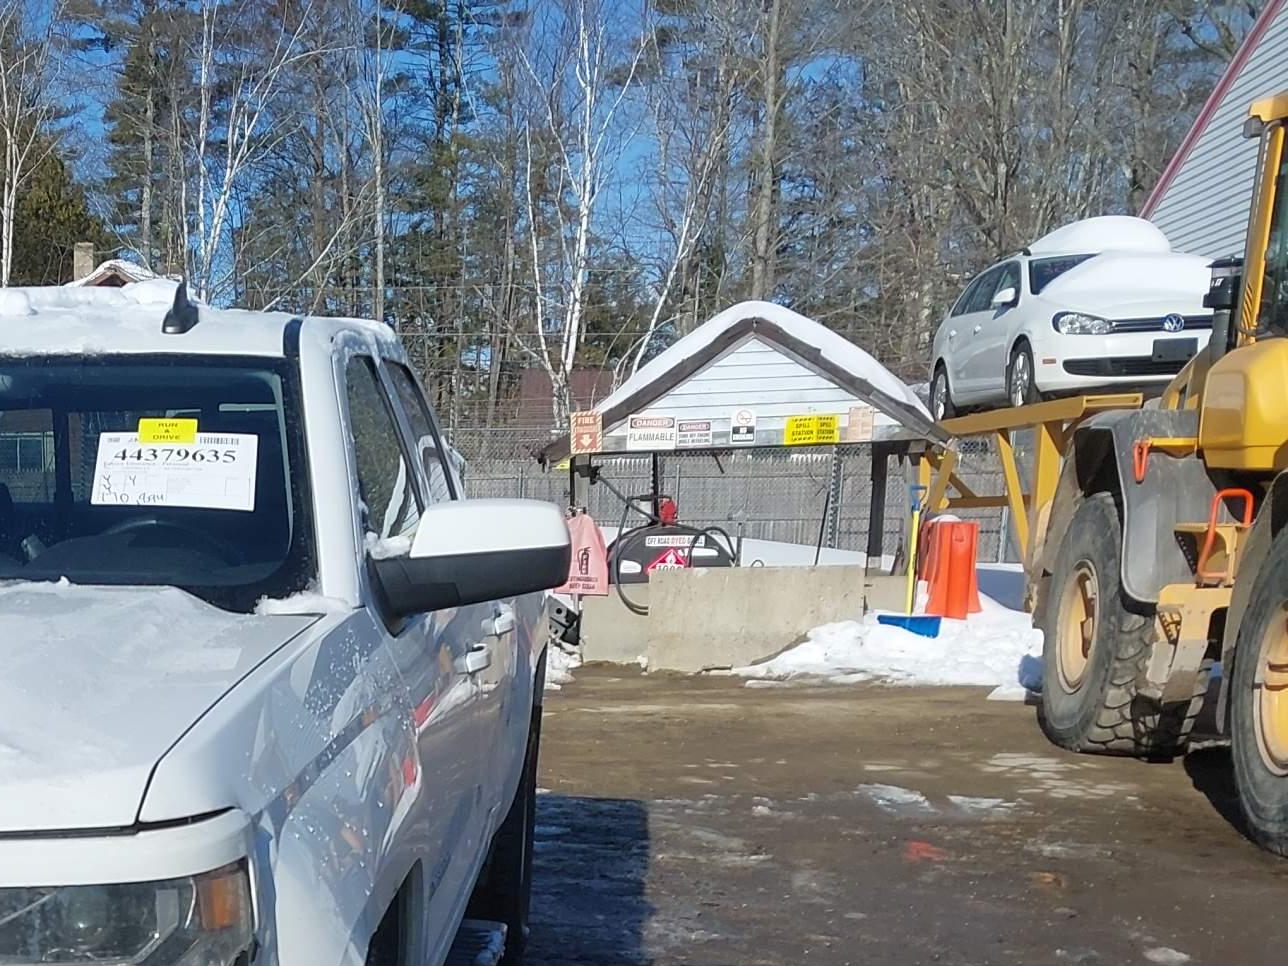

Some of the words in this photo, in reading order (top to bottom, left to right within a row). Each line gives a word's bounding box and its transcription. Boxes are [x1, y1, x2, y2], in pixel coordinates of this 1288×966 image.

[636, 419, 668, 427] DANGER
[629, 432, 674, 441] FLAMMABLE
[114, 448, 237, 464] 44379635
